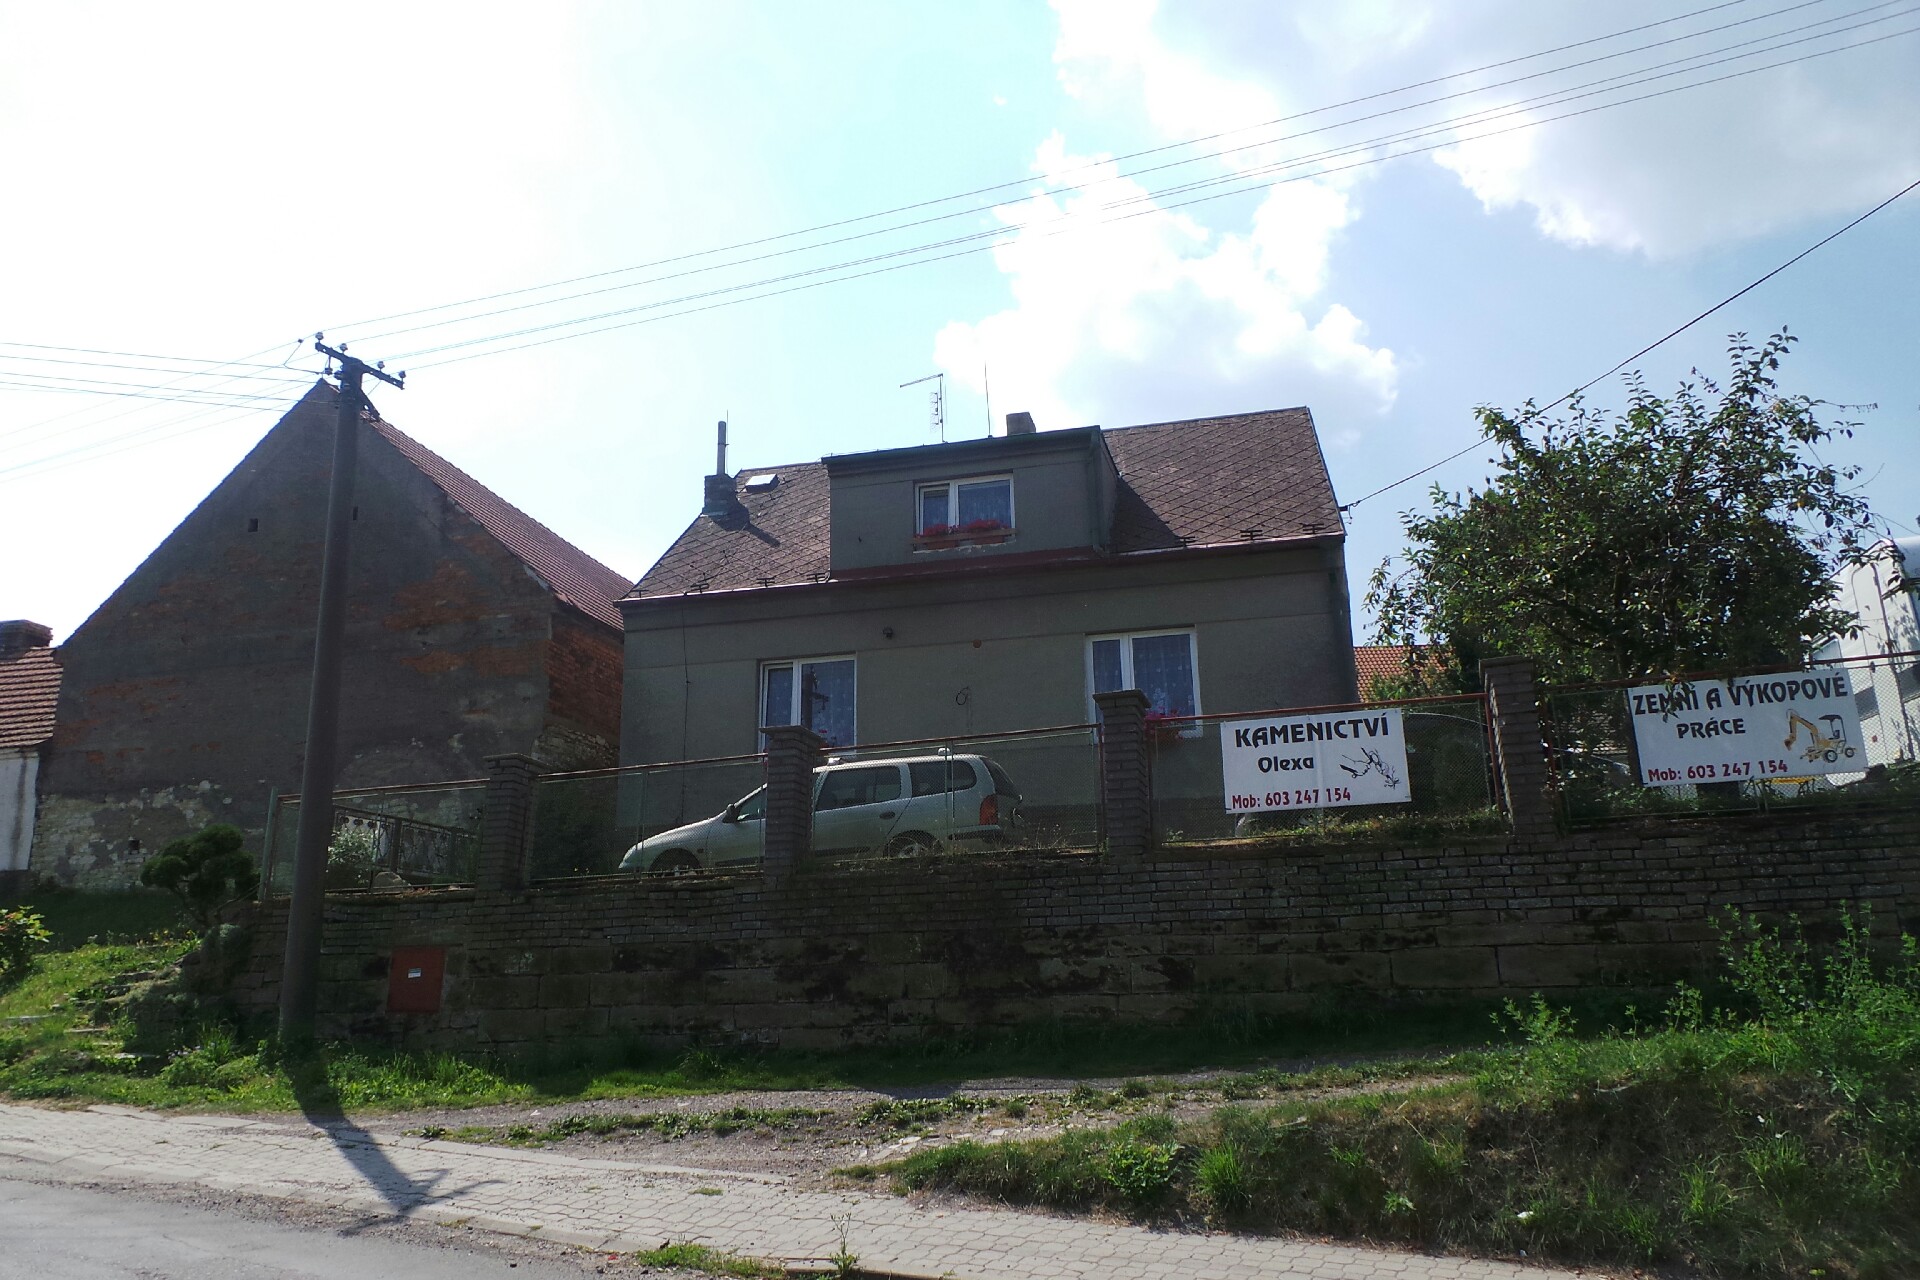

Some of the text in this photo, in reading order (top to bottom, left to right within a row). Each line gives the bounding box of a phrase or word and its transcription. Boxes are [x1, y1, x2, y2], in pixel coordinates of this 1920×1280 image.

[1706, 687, 1722, 710] A
[1728, 672, 1848, 707] VÝKOPOVÉ
[1235, 711, 1389, 748] KAMENICTVÍ
[1676, 717, 1746, 739] PRÁCE
[1257, 756, 1314, 773] Olexa
[1648, 759, 1788, 782] Mob: 603 247 154
[1232, 787, 1351, 809] Mob: 603 247 154
